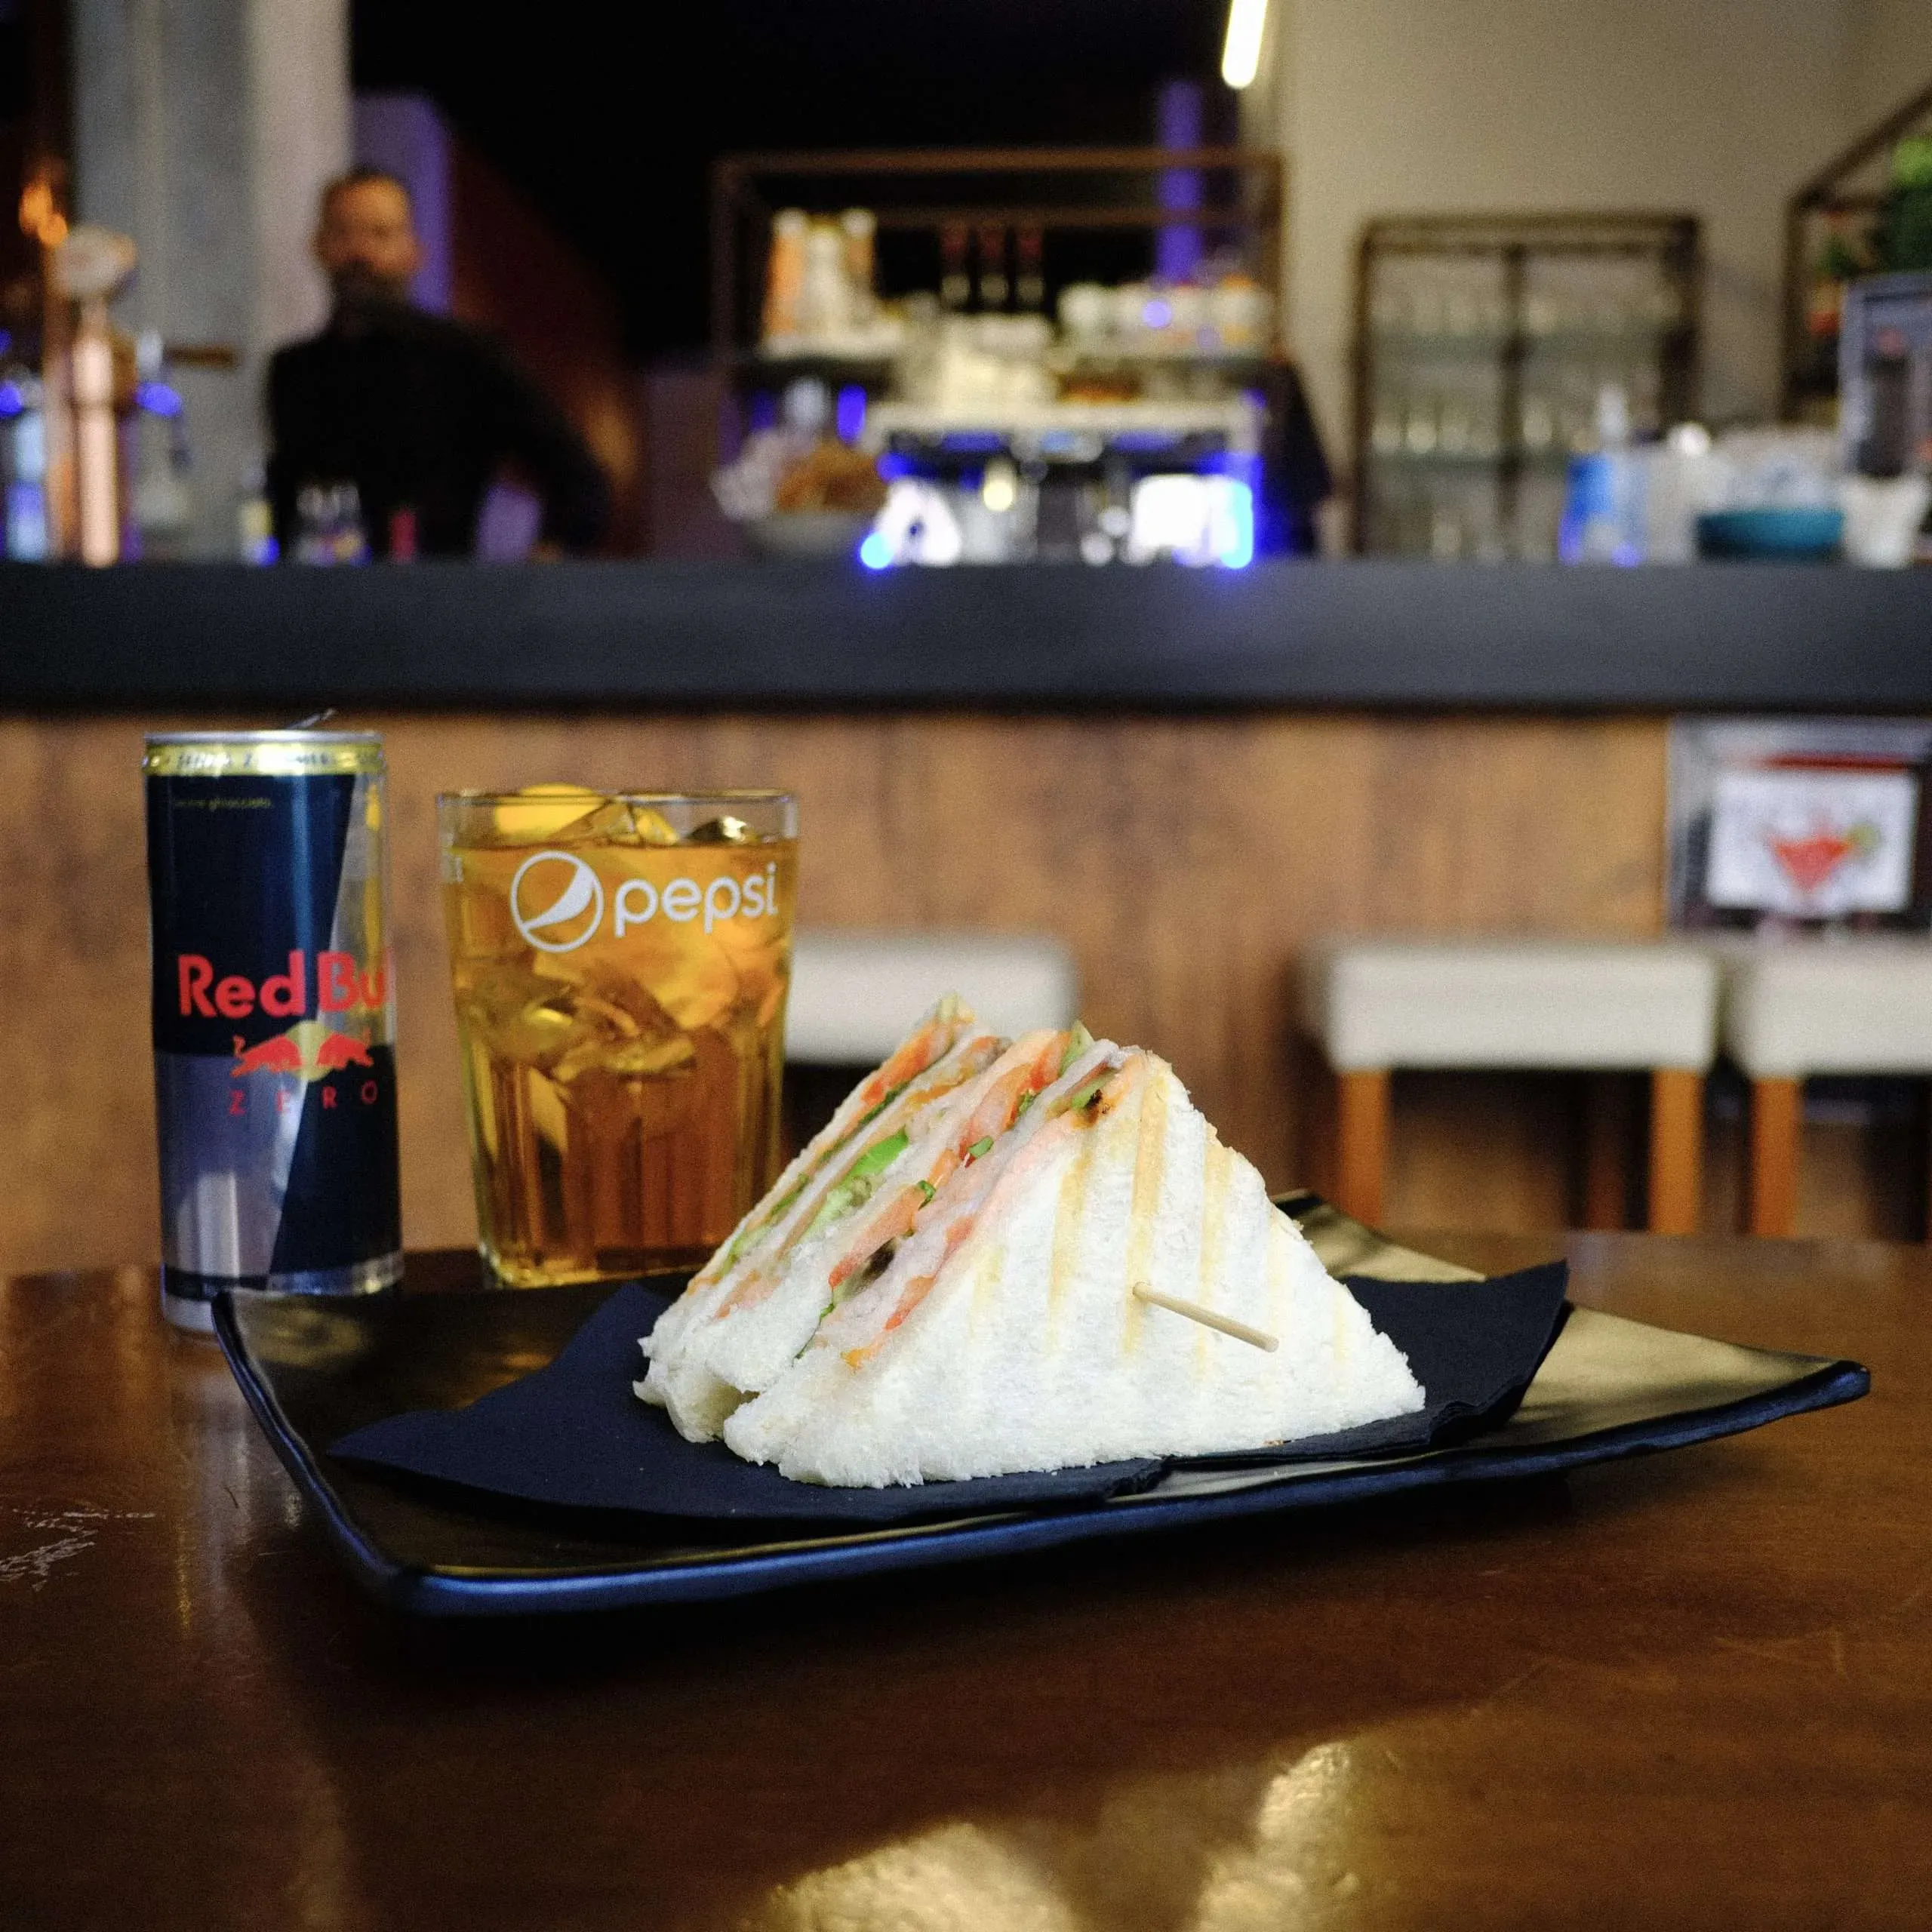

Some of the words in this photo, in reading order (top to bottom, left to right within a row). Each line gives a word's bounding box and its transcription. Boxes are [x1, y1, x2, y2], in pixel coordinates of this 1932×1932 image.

[615, 861, 778, 937] pepsi
[178, 950, 306, 1018] Red
[317, 949, 389, 1013] Bu
[229, 1080, 377, 1116] ZERO
